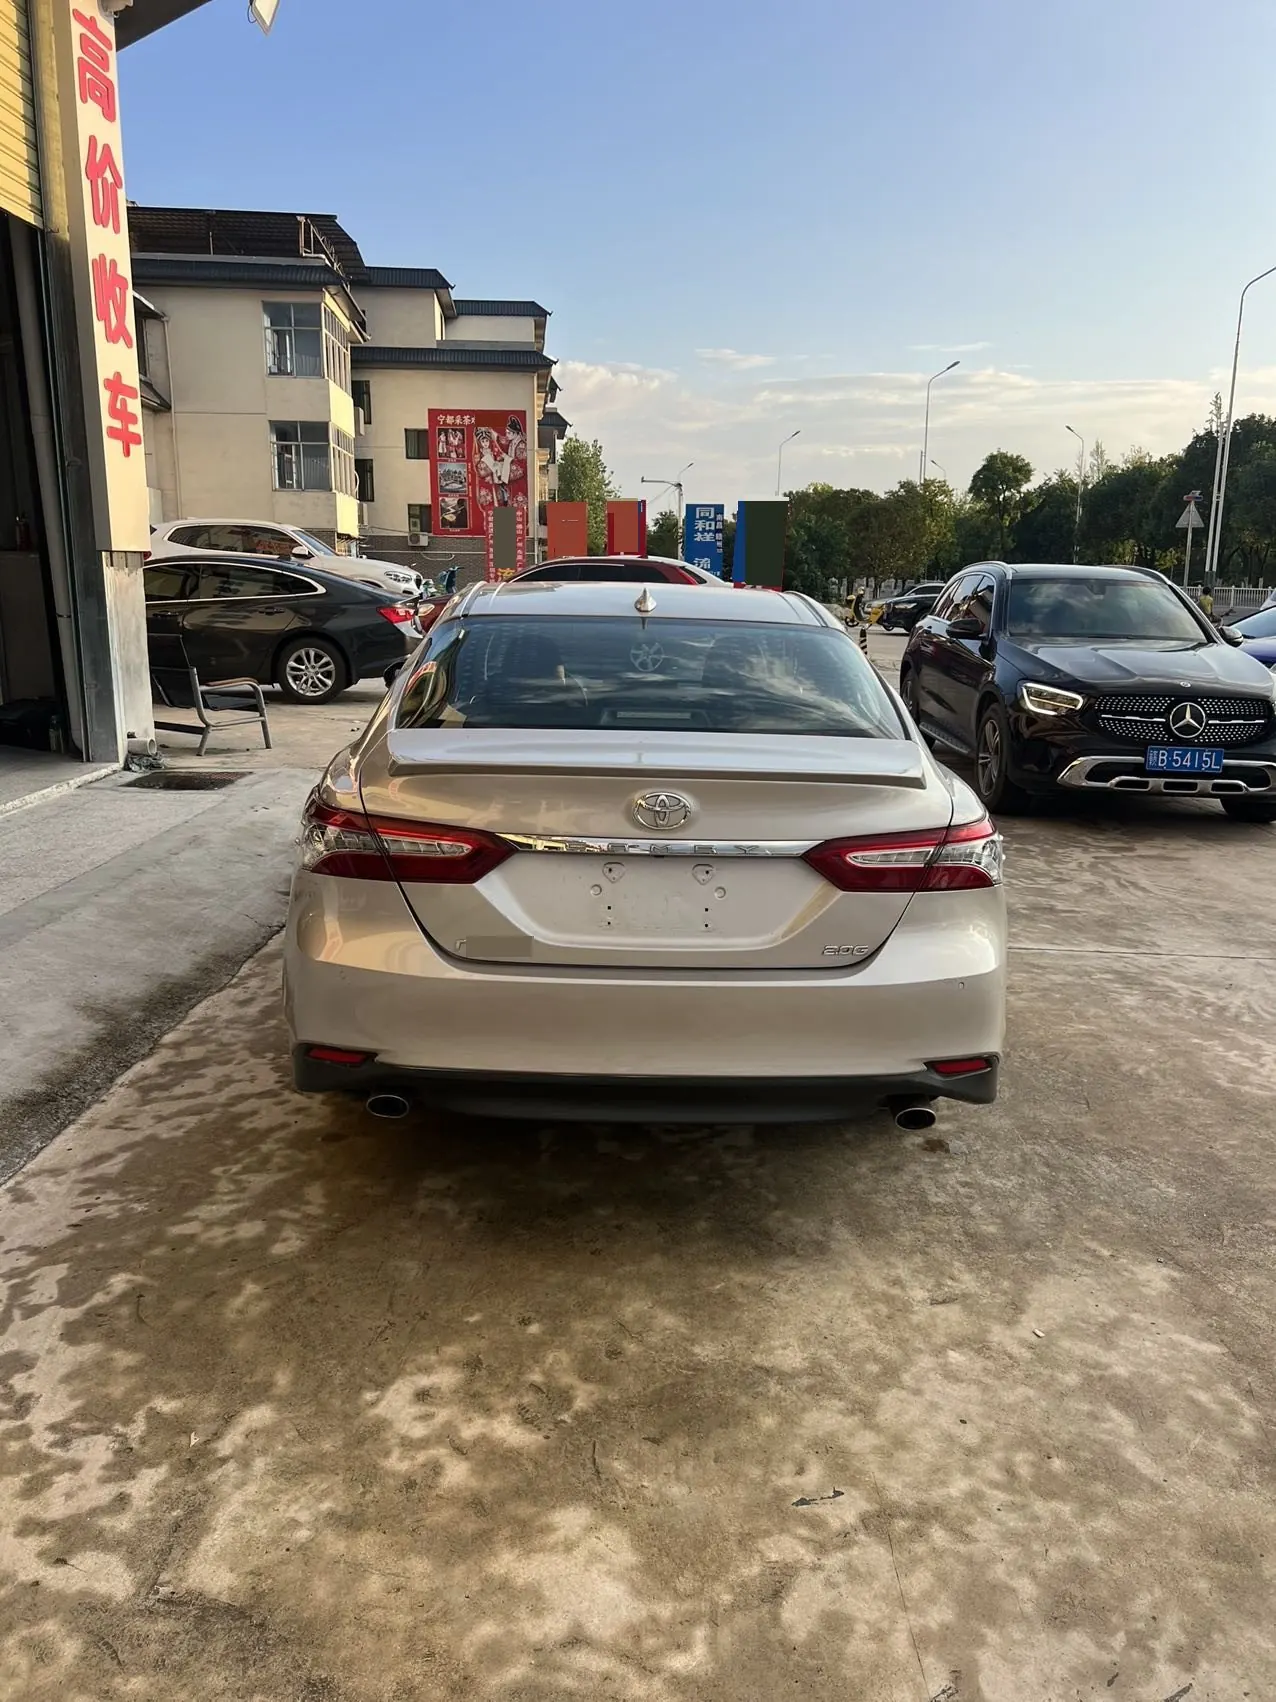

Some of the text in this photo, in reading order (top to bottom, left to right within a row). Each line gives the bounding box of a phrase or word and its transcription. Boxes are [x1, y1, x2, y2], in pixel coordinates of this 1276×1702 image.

[72, 8, 142, 457] 高价收车
[821, 944, 869, 956] 2.0G
